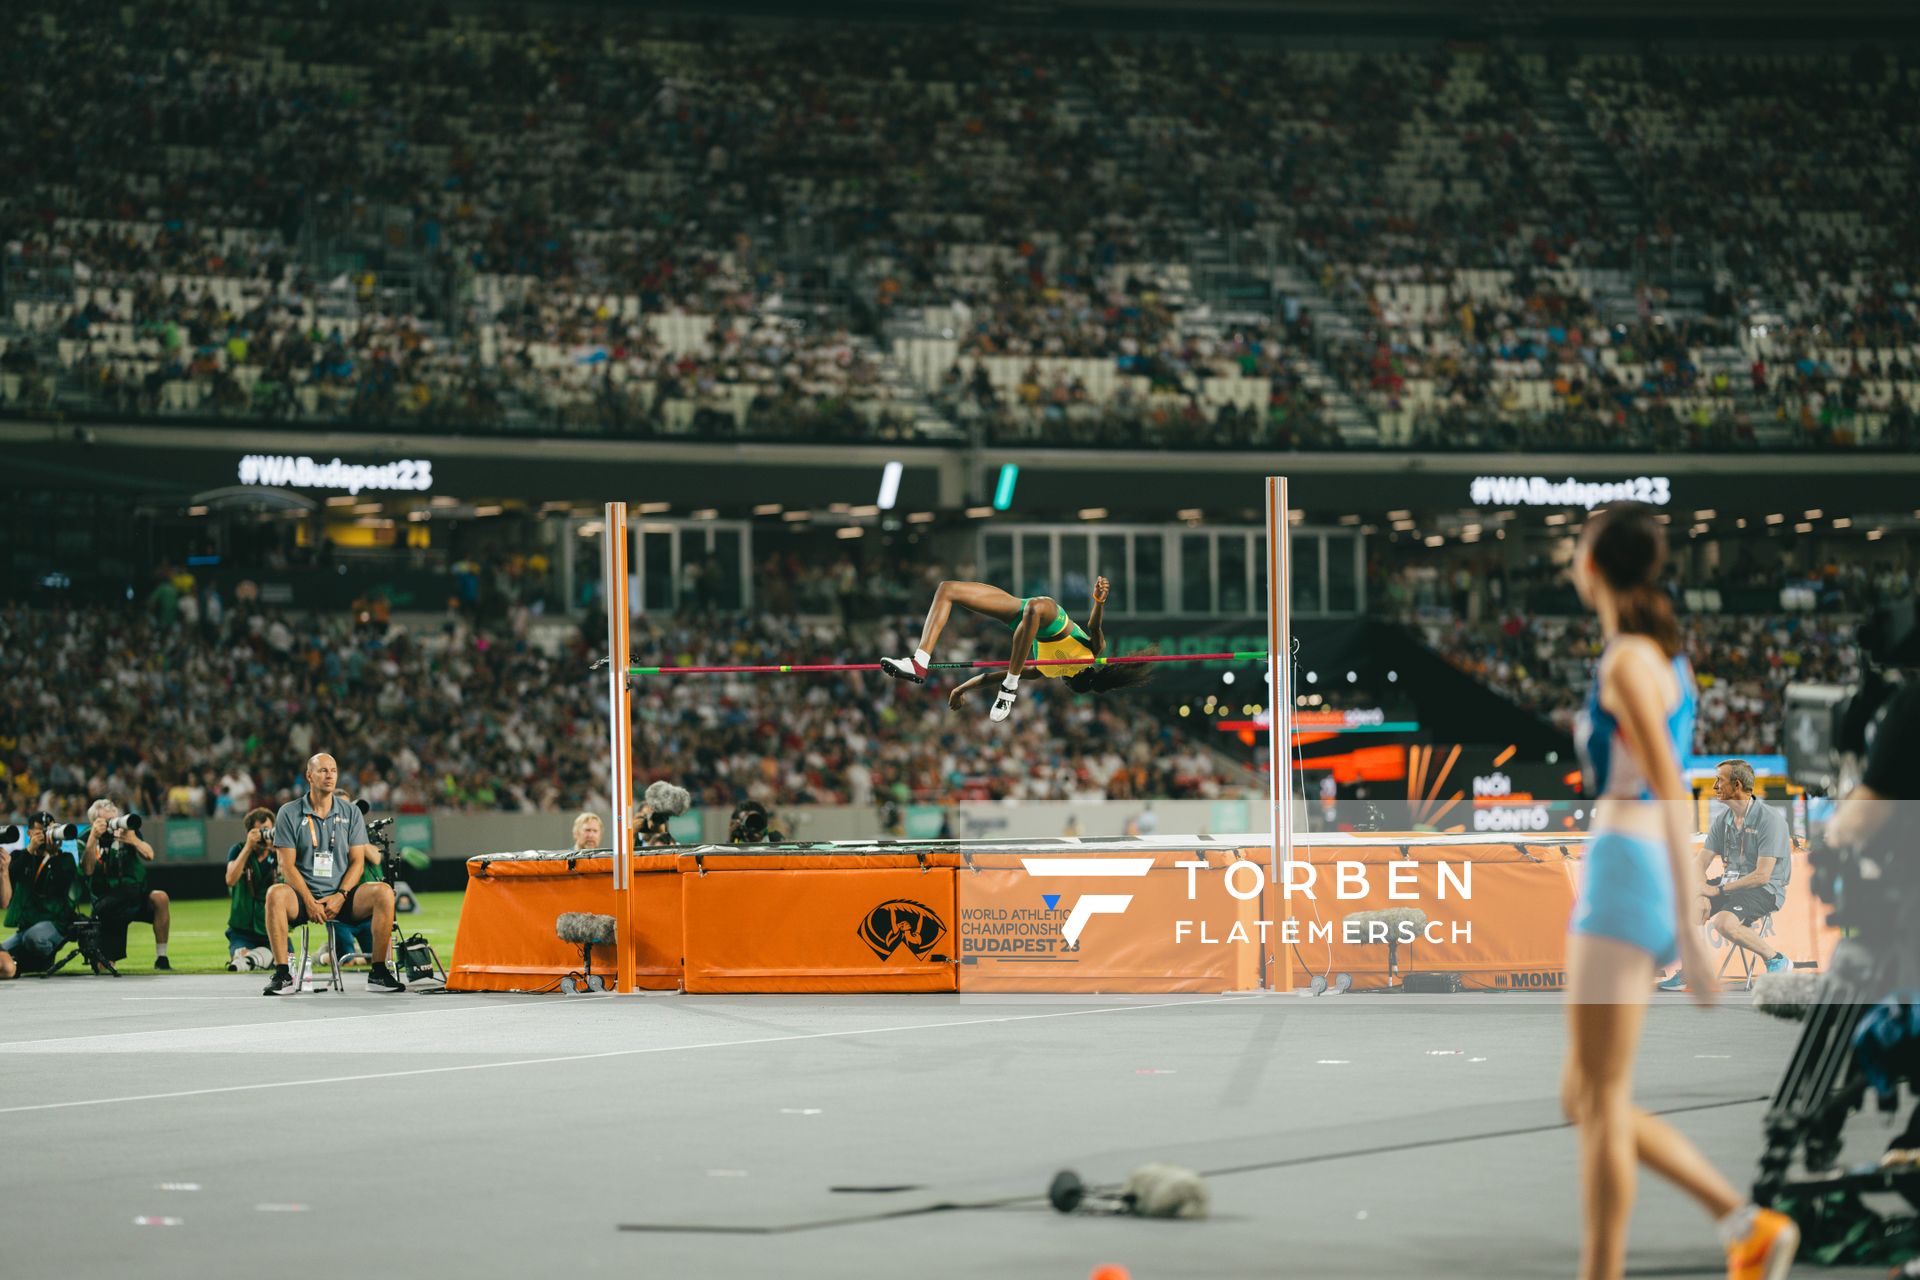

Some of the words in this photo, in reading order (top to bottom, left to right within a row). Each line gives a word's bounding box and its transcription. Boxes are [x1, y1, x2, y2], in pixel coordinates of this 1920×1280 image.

[238, 455, 433, 496] #WABudapest23
[961, 908, 1008, 920] WORLD
[1011, 908, 1072, 920] ATHLETIC
[961, 923, 1063, 935] CHAMPIONSHI
[962, 938, 1057, 952] BUDAPEST
[1511, 972, 1568, 987] MOND
